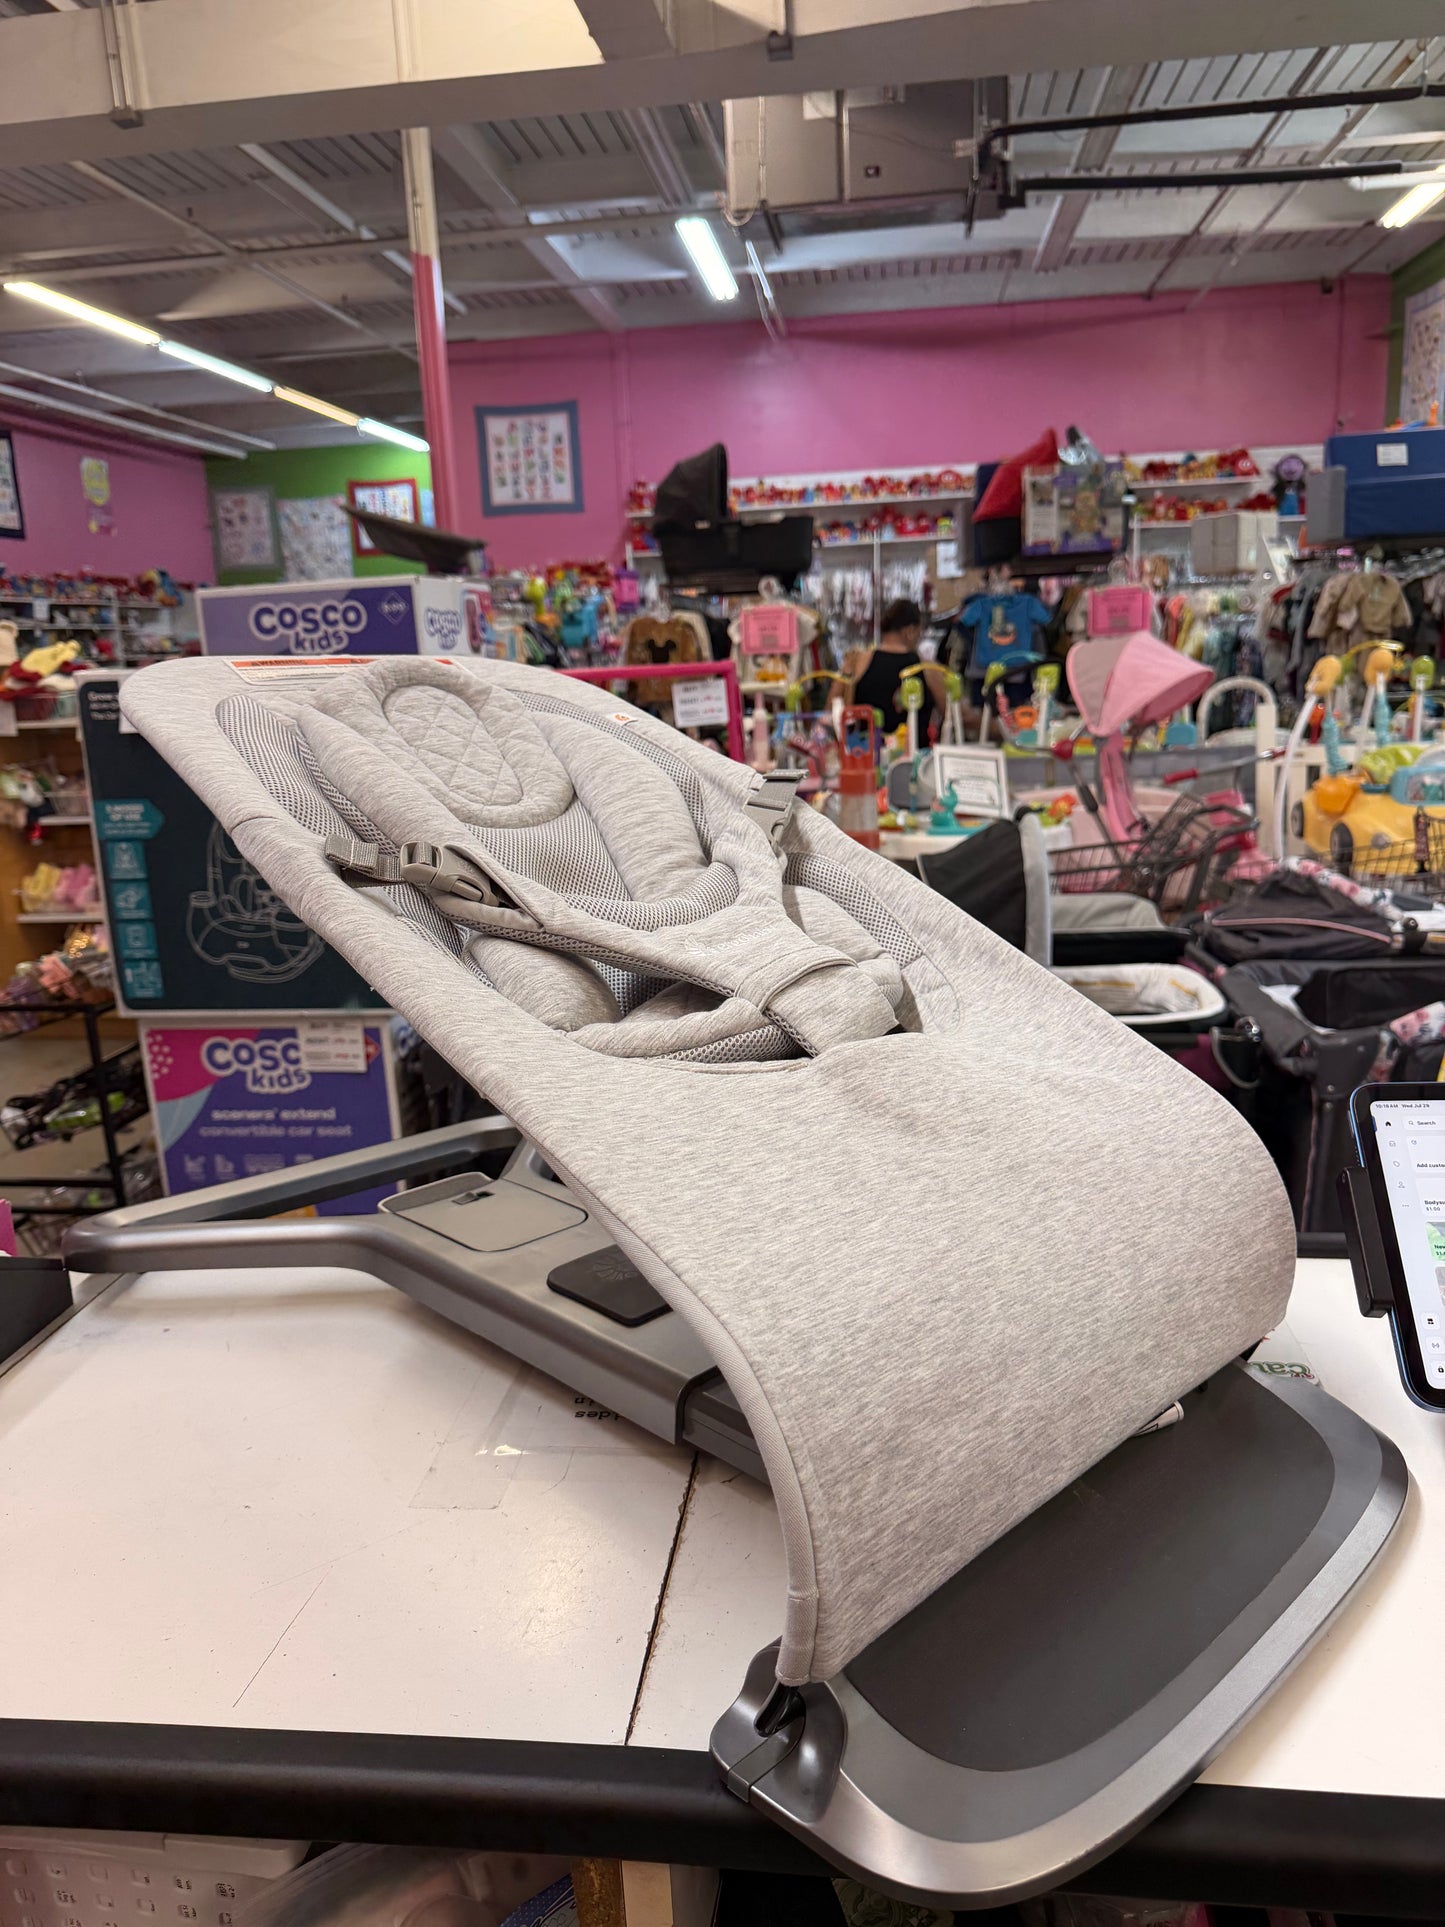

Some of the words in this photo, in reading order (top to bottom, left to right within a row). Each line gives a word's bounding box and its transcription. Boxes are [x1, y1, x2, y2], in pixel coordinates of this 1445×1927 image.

[293, 630, 345, 652] kids
[206, 1041, 299, 1071] COSC
[251, 1066, 307, 1088] kids
[281, 1106, 336, 1120] extend
[200, 1124, 285, 1137] convertible
[287, 1126, 312, 1137] car
[316, 1124, 351, 1137] seat
